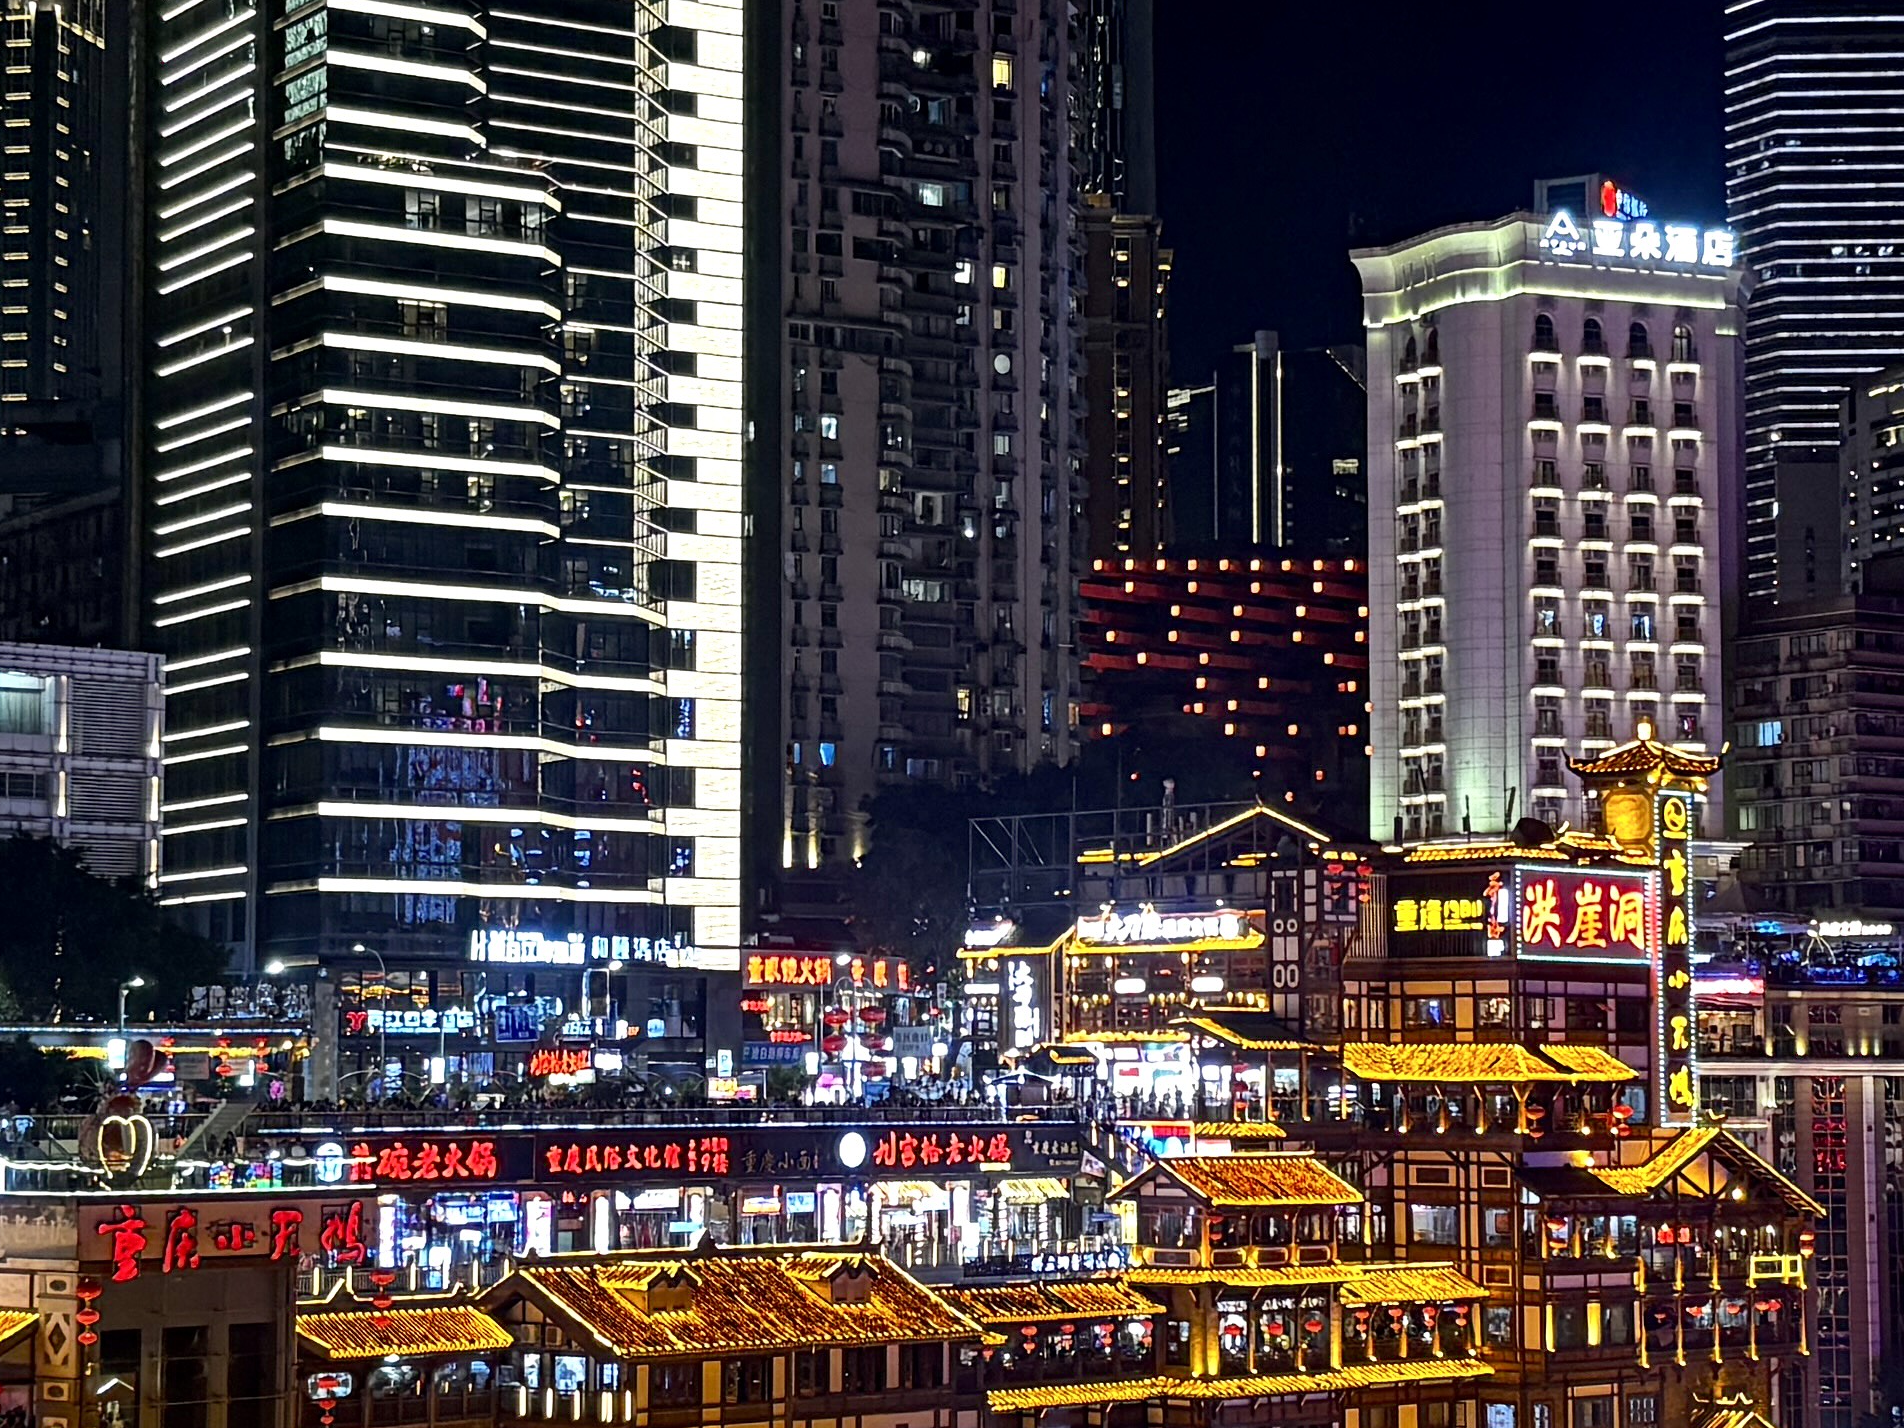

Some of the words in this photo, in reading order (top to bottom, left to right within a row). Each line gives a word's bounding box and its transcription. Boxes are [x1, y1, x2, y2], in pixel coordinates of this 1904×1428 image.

[1593, 221, 1734, 267] 亚朵酒店
[1523, 879, 1646, 950] 洪崖洞
